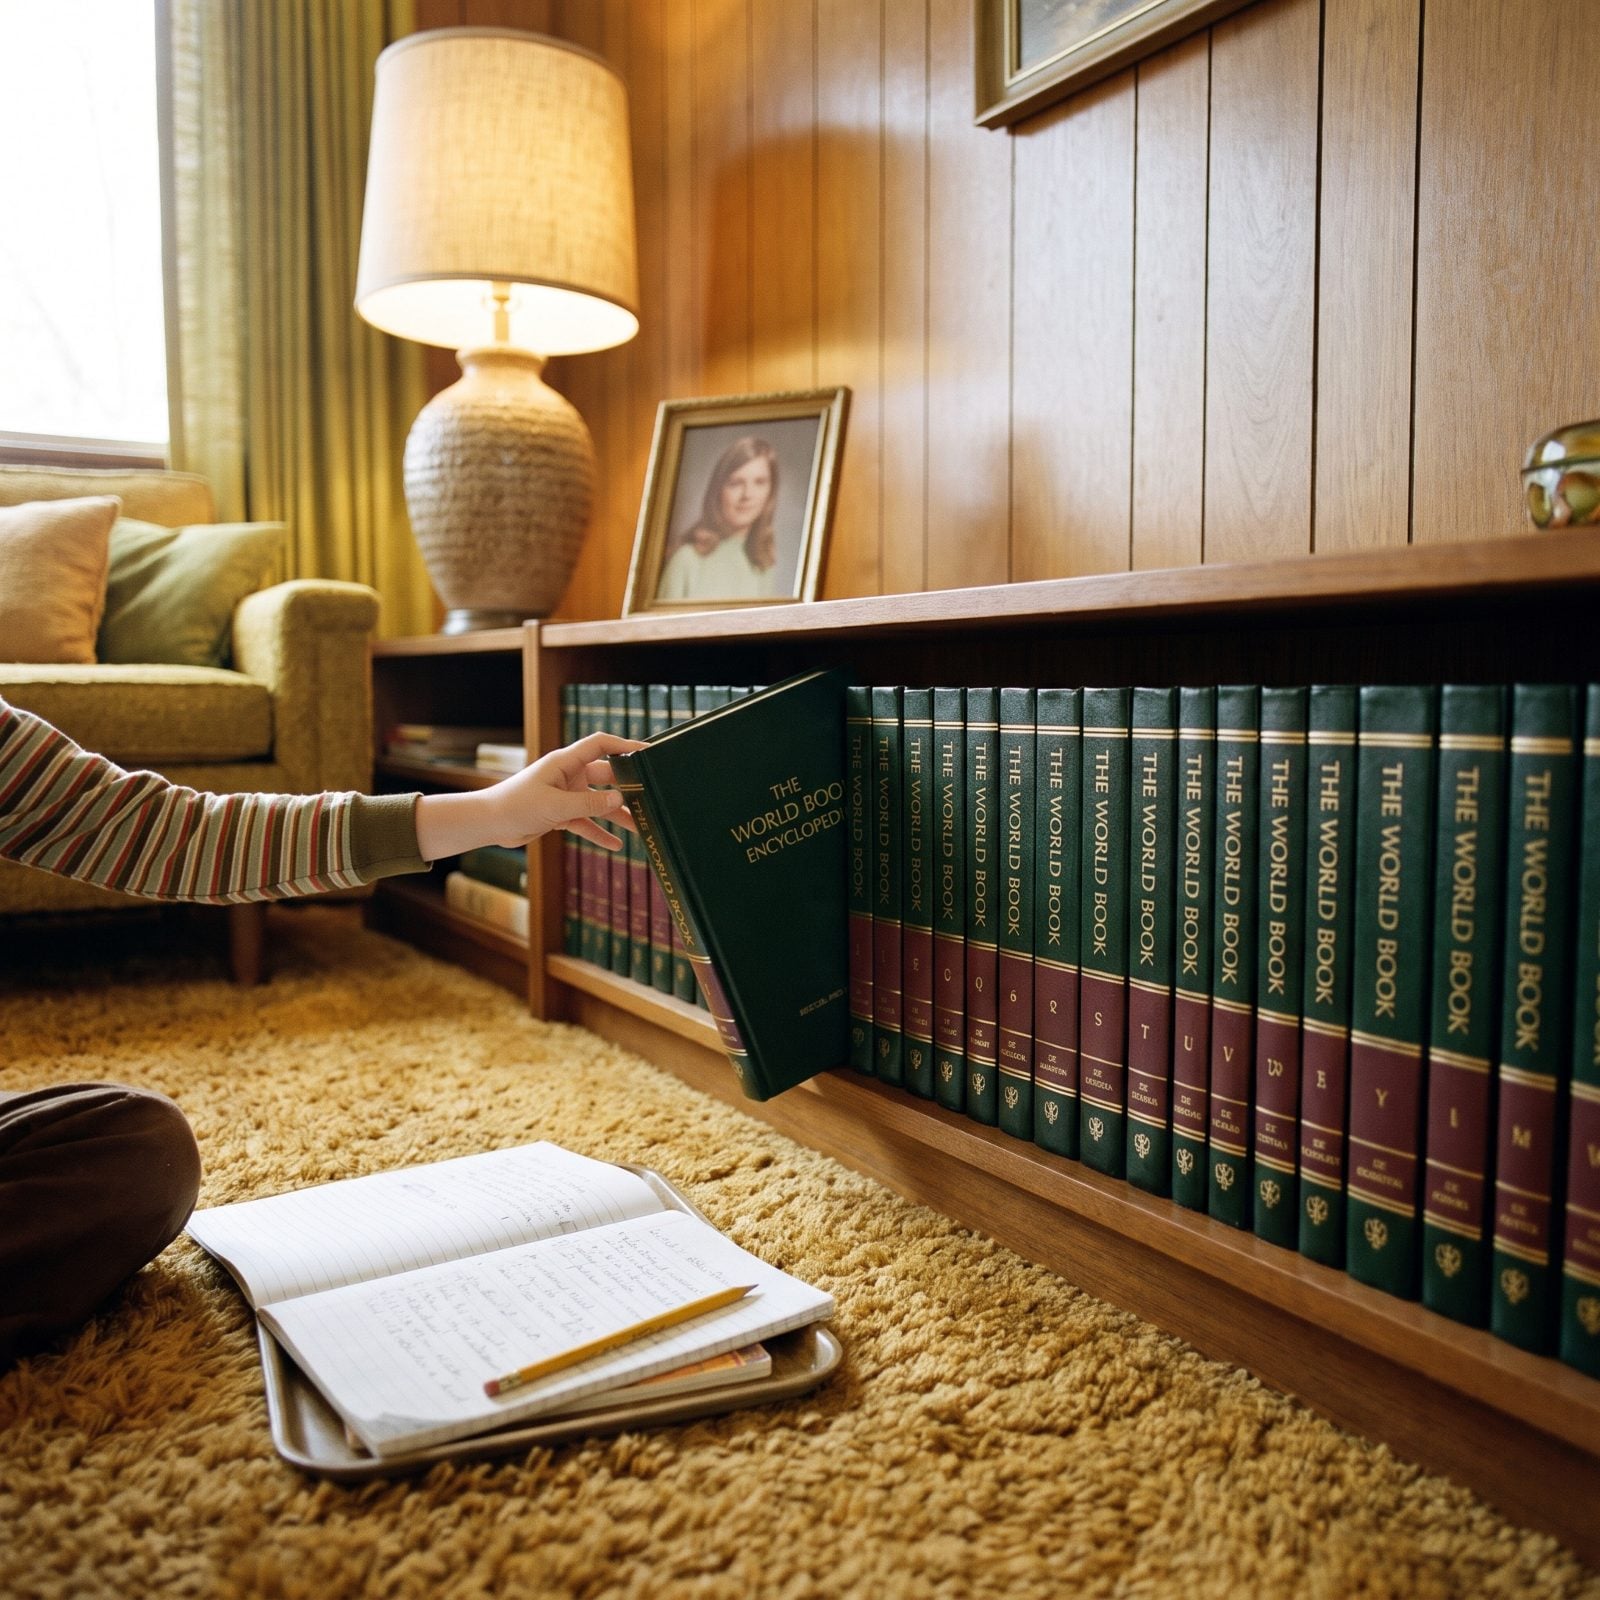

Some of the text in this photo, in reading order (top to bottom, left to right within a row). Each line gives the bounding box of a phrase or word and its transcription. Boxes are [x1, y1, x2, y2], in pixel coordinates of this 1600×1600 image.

[632, 799, 696, 947] THE WORLD BOOK
[730, 779, 846, 844] WORLD BOO
[746, 809, 847, 864] ENCYCLOPEDI
[769, 776, 802, 801] THE
[852, 736, 863, 898] THE WORLD BOOK
[880, 736, 890, 905] THE WORLD BOOK
[911, 738, 922, 912] THE WORLD BOOK
[942, 741, 954, 920] THE WORLD BOOK
[975, 742, 986, 928] THE WORLD BOOK
[1008, 745, 1022, 937] THE WORLD BOOK
[1048, 748, 1062, 946] THE WORLD BOOK
[1094, 750, 1109, 957] THE WORLD BOOK
[1140, 752, 1158, 966] THE WORLD BOOK
[1182, 754, 1202, 976] THE WORLD BOOK
[1222, 756, 1243, 985] THE WORLD BOOK
[1268, 759, 1289, 996] THE WORLD BOOK
[1315, 760, 1340, 1005] THE WORLD BOOK
[1375, 763, 1403, 1019] THE WORLD BOOK
[1448, 766, 1480, 1036] THE WORLD BOOK
[1514, 770, 1550, 1052] THE WORLD BOOK
[944, 968, 952, 982] C
[975, 976, 984, 992] Q
[1094, 1012, 1103, 1027] S
[1140, 1023, 1150, 1040] T
[1184, 1035, 1194, 1051] U
[1222, 1046, 1234, 1062] V
[1375, 1088, 1388, 1108] Y
